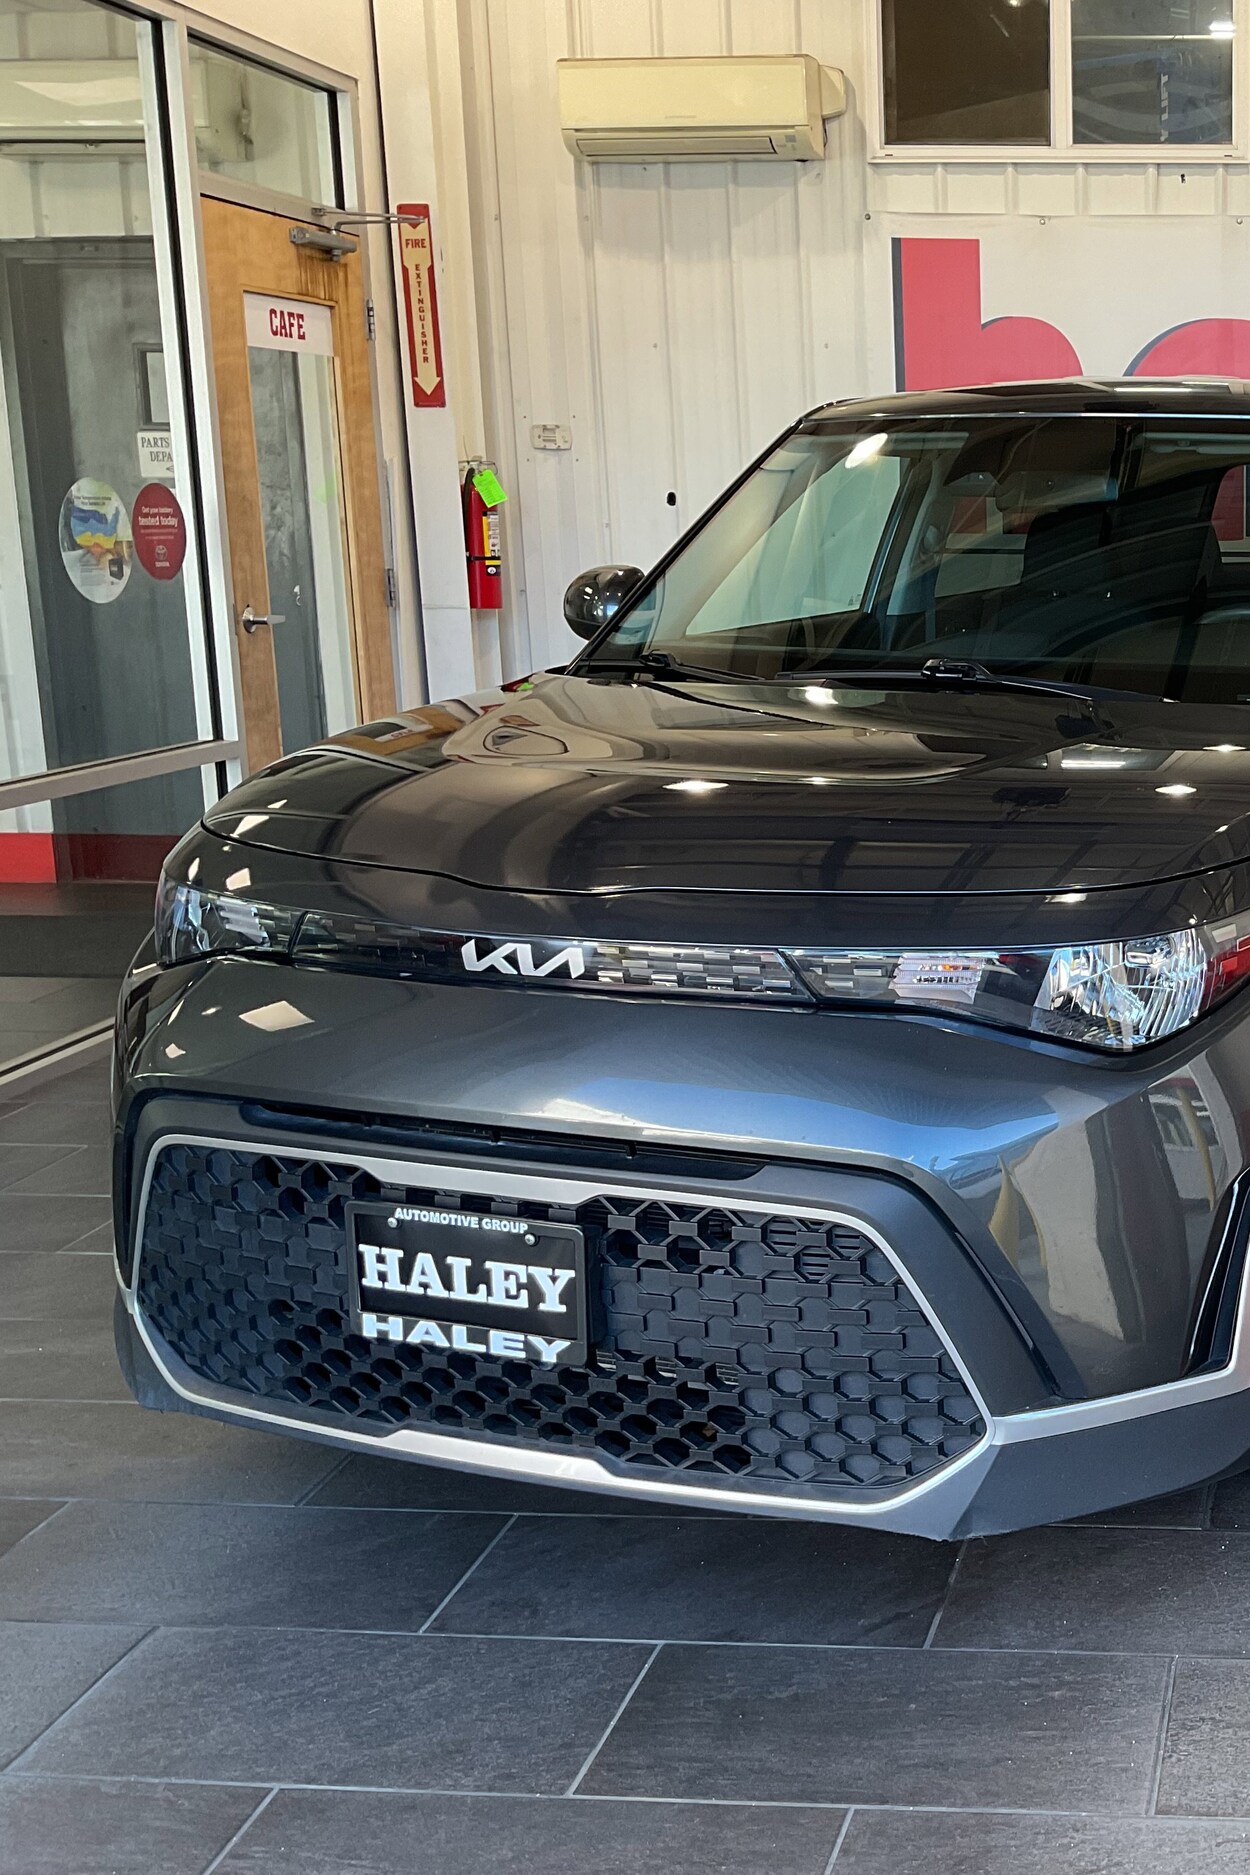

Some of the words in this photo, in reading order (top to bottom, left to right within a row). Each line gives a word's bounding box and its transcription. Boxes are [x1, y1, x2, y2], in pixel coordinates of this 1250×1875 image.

[1161, 73, 1169, 121] LIFT
[405, 238, 427, 249] FIRE
[269, 307, 306, 341] CAFE
[415, 263, 429, 364] EXTINGUISHER
[141, 437, 170, 448] PARTS
[138, 515, 160, 526] tested
[160, 515, 178, 528] today
[461, 938, 586, 979] KIA
[394, 1207, 479, 1229] AUTOMOTIVE
[481, 1217, 529, 1234] GROUP
[358, 1243, 576, 1313] HALEY
[362, 1313, 572, 1363] HALEY
